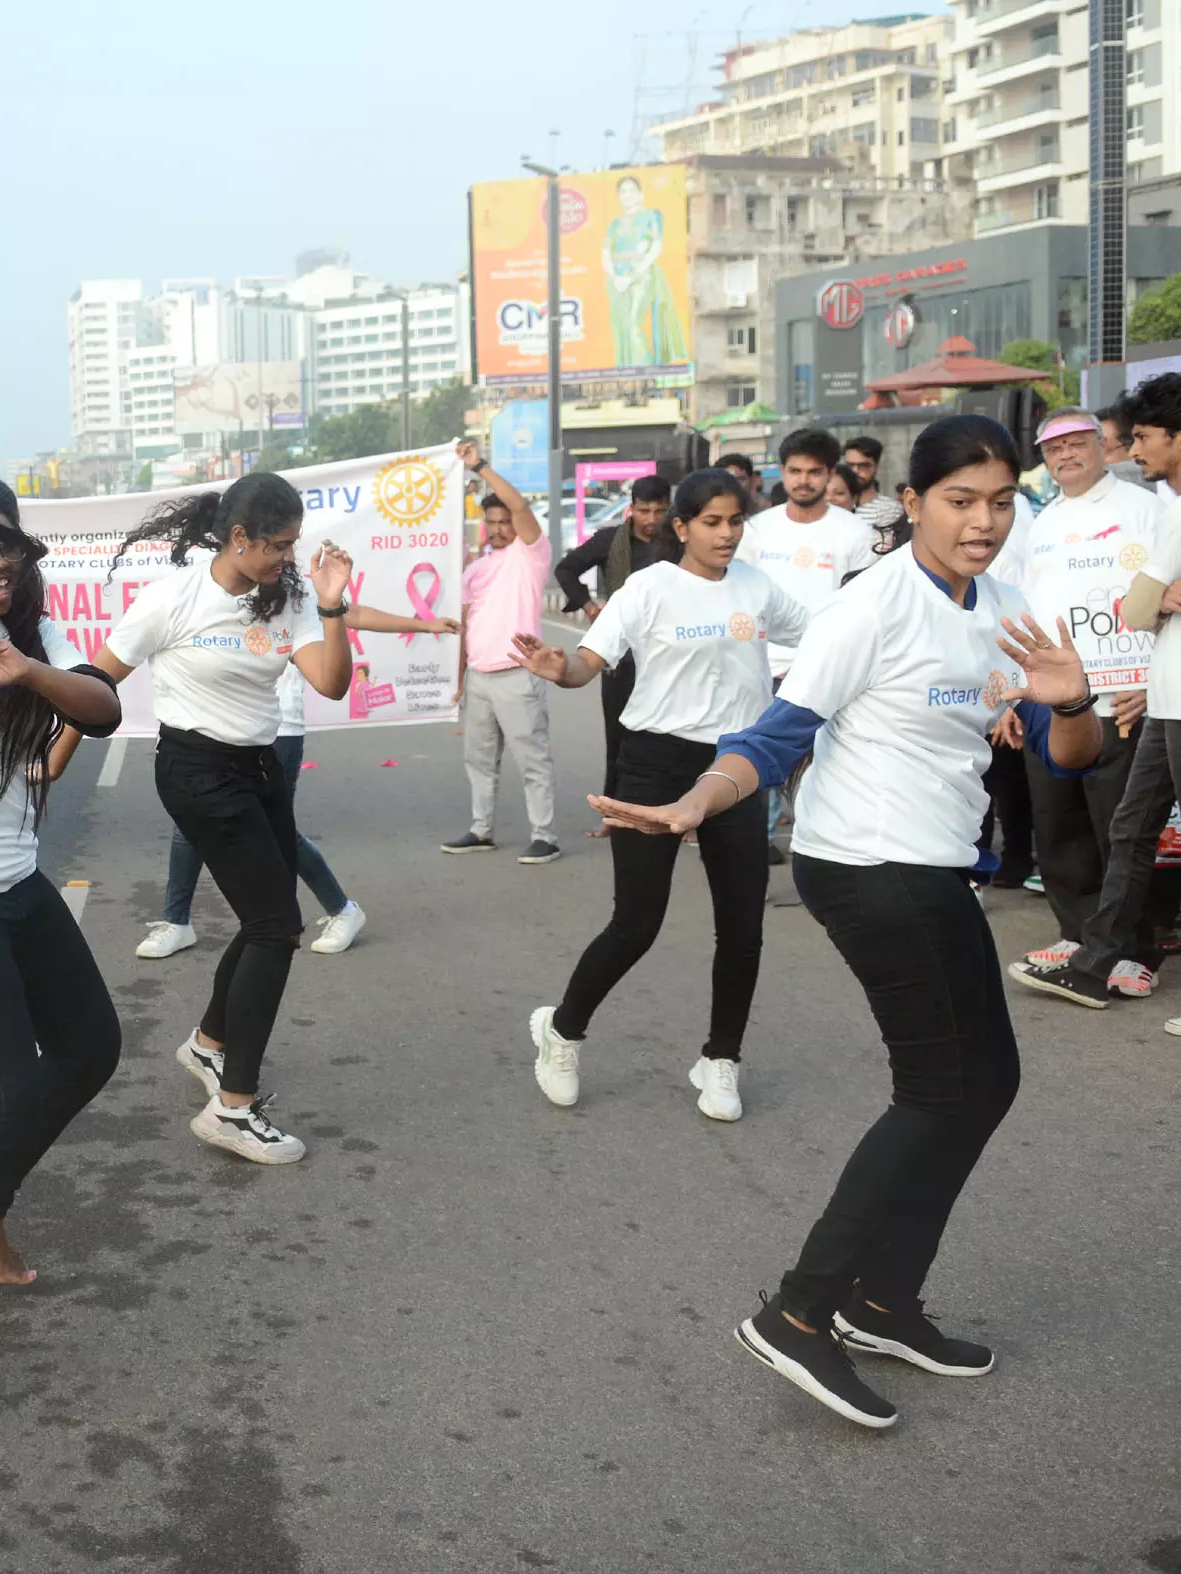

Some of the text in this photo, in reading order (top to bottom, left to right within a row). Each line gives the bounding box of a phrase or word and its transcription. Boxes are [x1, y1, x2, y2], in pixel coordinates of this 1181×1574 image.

[299, 485, 361, 513] ary
[36, 532, 66, 545] intly
[371, 532, 449, 551] RID 3020
[39, 559, 85, 569] OTARY
[89, 558, 133, 569] CLUBS
[137, 557, 151, 567] of
[1068, 555, 1115, 570] Rotary
[675, 623, 727, 641] Rotary
[193, 634, 241, 649] Rotary
[1084, 659, 1103, 669] TARY
[1139, 653, 1151, 663] VIZ
[928, 687, 982, 706] Rotary
